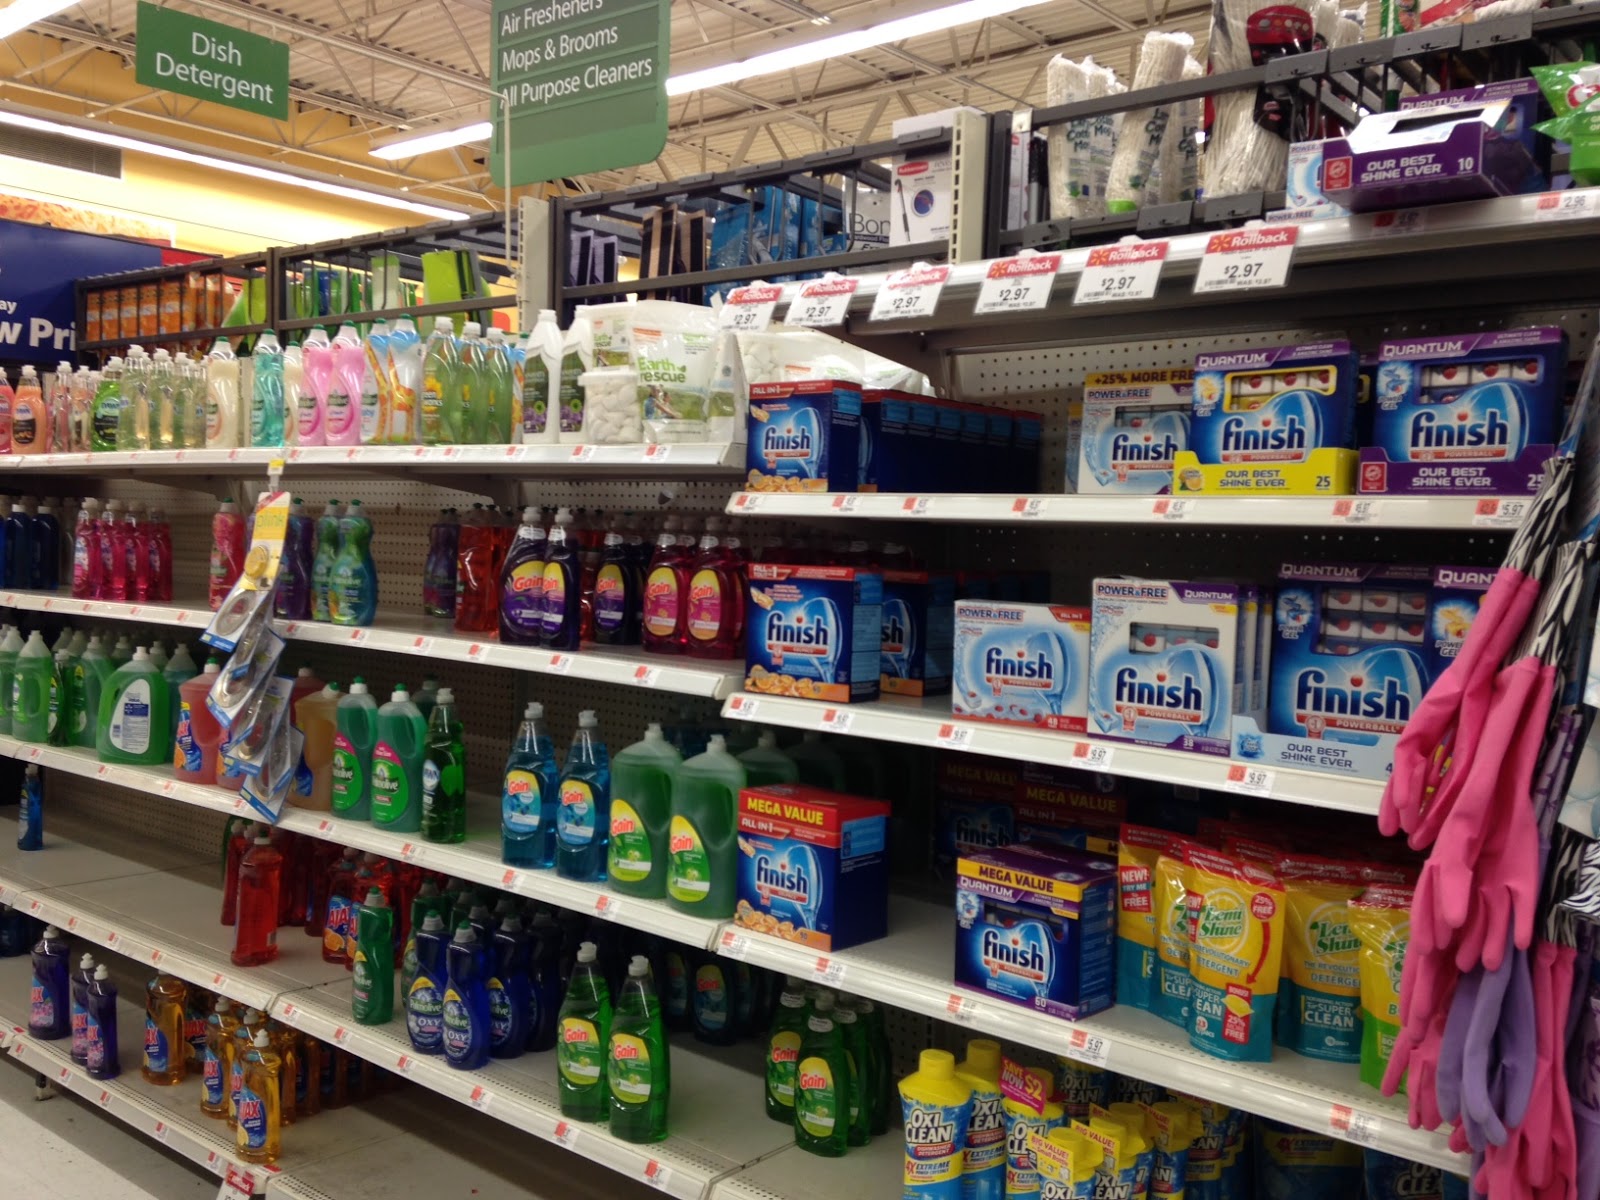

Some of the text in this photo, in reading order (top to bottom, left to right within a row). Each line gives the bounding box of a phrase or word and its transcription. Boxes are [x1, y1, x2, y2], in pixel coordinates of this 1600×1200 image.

[502, 0, 602, 36] Air Fresheners
[192, 32, 242, 66] Dish
[503, 26, 618, 72] Mops & Brooms
[156, 52, 273, 104] Detergent
[500, 58, 652, 110] All Purpose Cleaners
[1368, 154, 1435, 171] OUR BEST
[1458, 157, 1474, 171] 10
[1361, 163, 1442, 183] SHINE EVER
[1231, 232, 1289, 247] Rollback
[1109, 247, 1159, 260] Rollback
[1007, 259, 1053, 273] Rollback
[1224, 263, 1263, 278] $2.97
[1102, 276, 1136, 291] $2.97
[893, 296, 920, 309] $2.97
[1000, 288, 1030, 302] $2.97
[734, 314, 757, 325] $2.97
[806, 306, 831, 318] $2.97
[1384, 340, 1463, 357] QUANTUM
[638, 357, 675, 372] Earth
[1200, 353, 1267, 368] QUANTUM
[640, 370, 686, 382] rescue
[1095, 373, 1127, 385] +25%
[1131, 372, 1167, 383] MORE
[1224, 416, 1306, 450] finish
[1412, 410, 1510, 447] finish
[764, 426, 810, 450] finish
[1112, 434, 1178, 461] finish
[1226, 469, 1281, 479] OUR BEST
[1419, 467, 1486, 477] OUR BEST
[1220, 478, 1286, 487] SHINE EVER
[1316, 476, 1330, 488] 25
[1412, 477, 1491, 486] SHINE EVER
[1282, 563, 1360, 578] QUANTUM
[513, 576, 543, 592] Gain
[648, 583, 670, 598] Gain
[691, 585, 713, 600] Gain
[1185, 590, 1233, 600] QUANTUM
[768, 612, 829, 646] finish
[986, 648, 1052, 680] finish
[1117, 668, 1202, 712] finish
[1297, 670, 1410, 722] finish
[1336, 720, 1400, 733] POWERBALL
[1288, 743, 1348, 758] OUR BEST
[1281, 752, 1352, 768] SHINE EVER
[508, 780, 530, 795] Gain
[562, 790, 583, 806] Gain
[1026, 786, 1117, 812] MEGA VALUE
[747, 796, 824, 826] MEGA VALUE
[611, 818, 635, 836] Gain
[742, 818, 756, 829] ALL
[670, 836, 694, 854] Gain
[757, 857, 808, 894] finish
[979, 866, 1054, 893] MEGA VALUE
[1122, 869, 1148, 882] NEW!
[960, 876, 1014, 898] QUANTUM
[1124, 896, 1148, 908] FREE
[1252, 904, 1273, 914] FREE
[1199, 920, 1242, 938] Shine
[984, 930, 1044, 972] finish
[1035, 996, 1046, 1008] 60
[1318, 1004, 1351, 1016] SUPER
[418, 1018, 441, 1026] OXY
[1305, 1011, 1354, 1028] CLEAN
[448, 1031, 467, 1042] OXY
[564, 1028, 588, 1044] Gain
[1225, 1029, 1244, 1040] FREE
[614, 1044, 638, 1060] Gain
[772, 1047, 798, 1064] Gain
[1004, 1060, 1024, 1077] SAVE
[800, 1073, 826, 1090] Gain
[1002, 1070, 1042, 1101] NOW $2
[1064, 1074, 1088, 1087] OXI
[912, 1108, 941, 1126] OXI
[906, 1122, 952, 1144] CLEAN
[1076, 1124, 1116, 1148] BIG VALUE!
[1032, 1136, 1068, 1159] BIG VALUE!
[906, 1160, 950, 1174] 4X EXTREME
[1046, 1182, 1072, 1200] OXI
